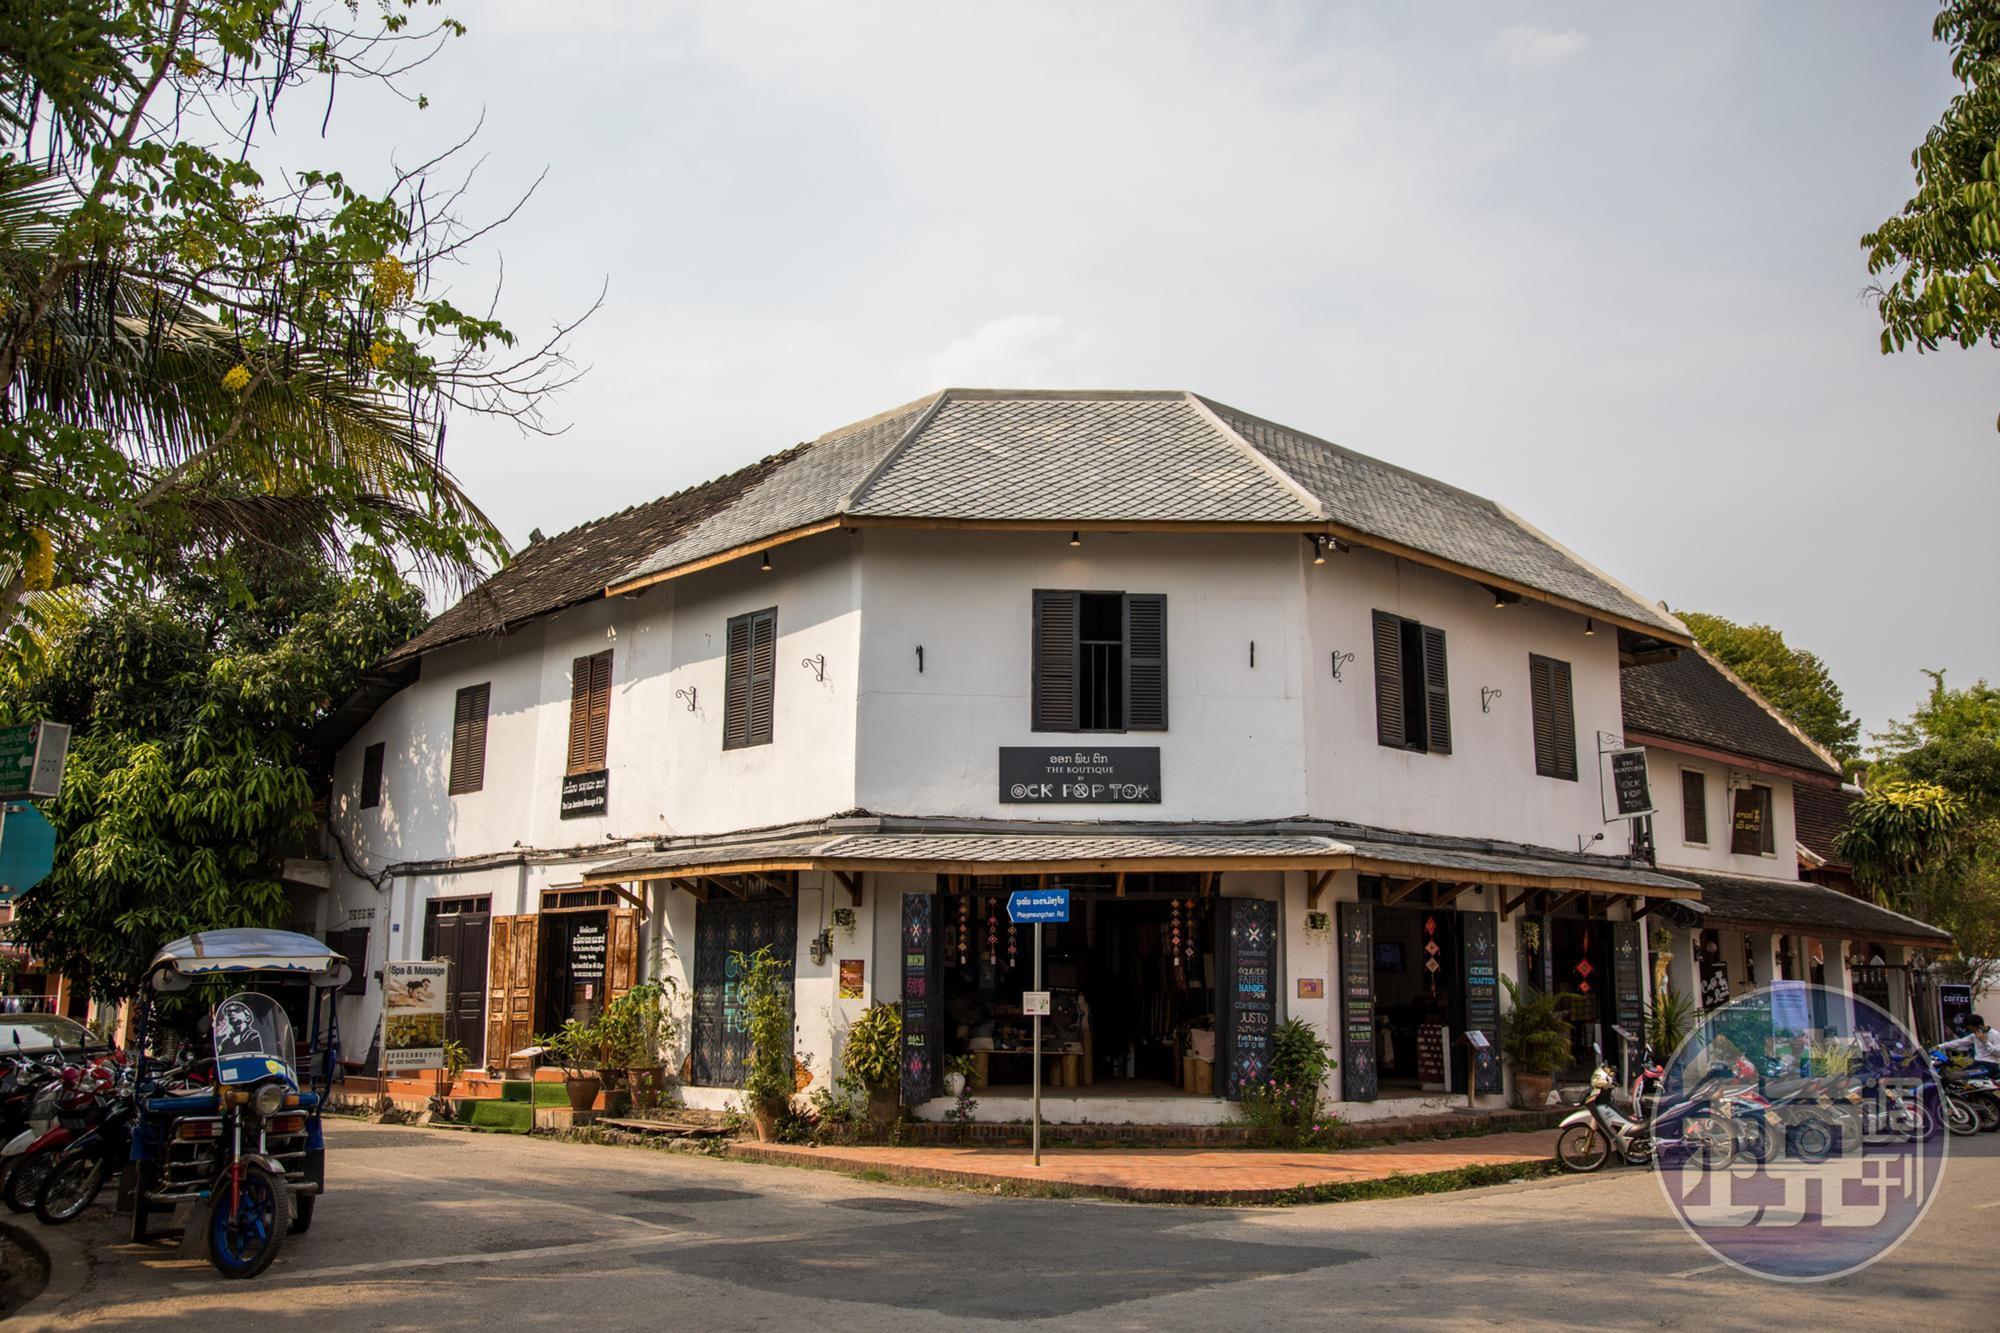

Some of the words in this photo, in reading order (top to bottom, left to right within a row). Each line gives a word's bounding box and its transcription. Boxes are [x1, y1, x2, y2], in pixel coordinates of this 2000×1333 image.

[1045, 766, 1064, 774] THE
[1066, 766, 1114, 775] BOUTIQUE
[1010, 783, 1053, 799] OCK
[1062, 783, 1105, 799] POP
[1109, 783, 1150, 799] TOK
[391, 965, 405, 976] Spa
[406, 966, 413, 975] &
[414, 966, 445, 977] Massage
[1943, 995, 1969, 1003] COFFEE
[1240, 1012, 1268, 1024] JUSTO
